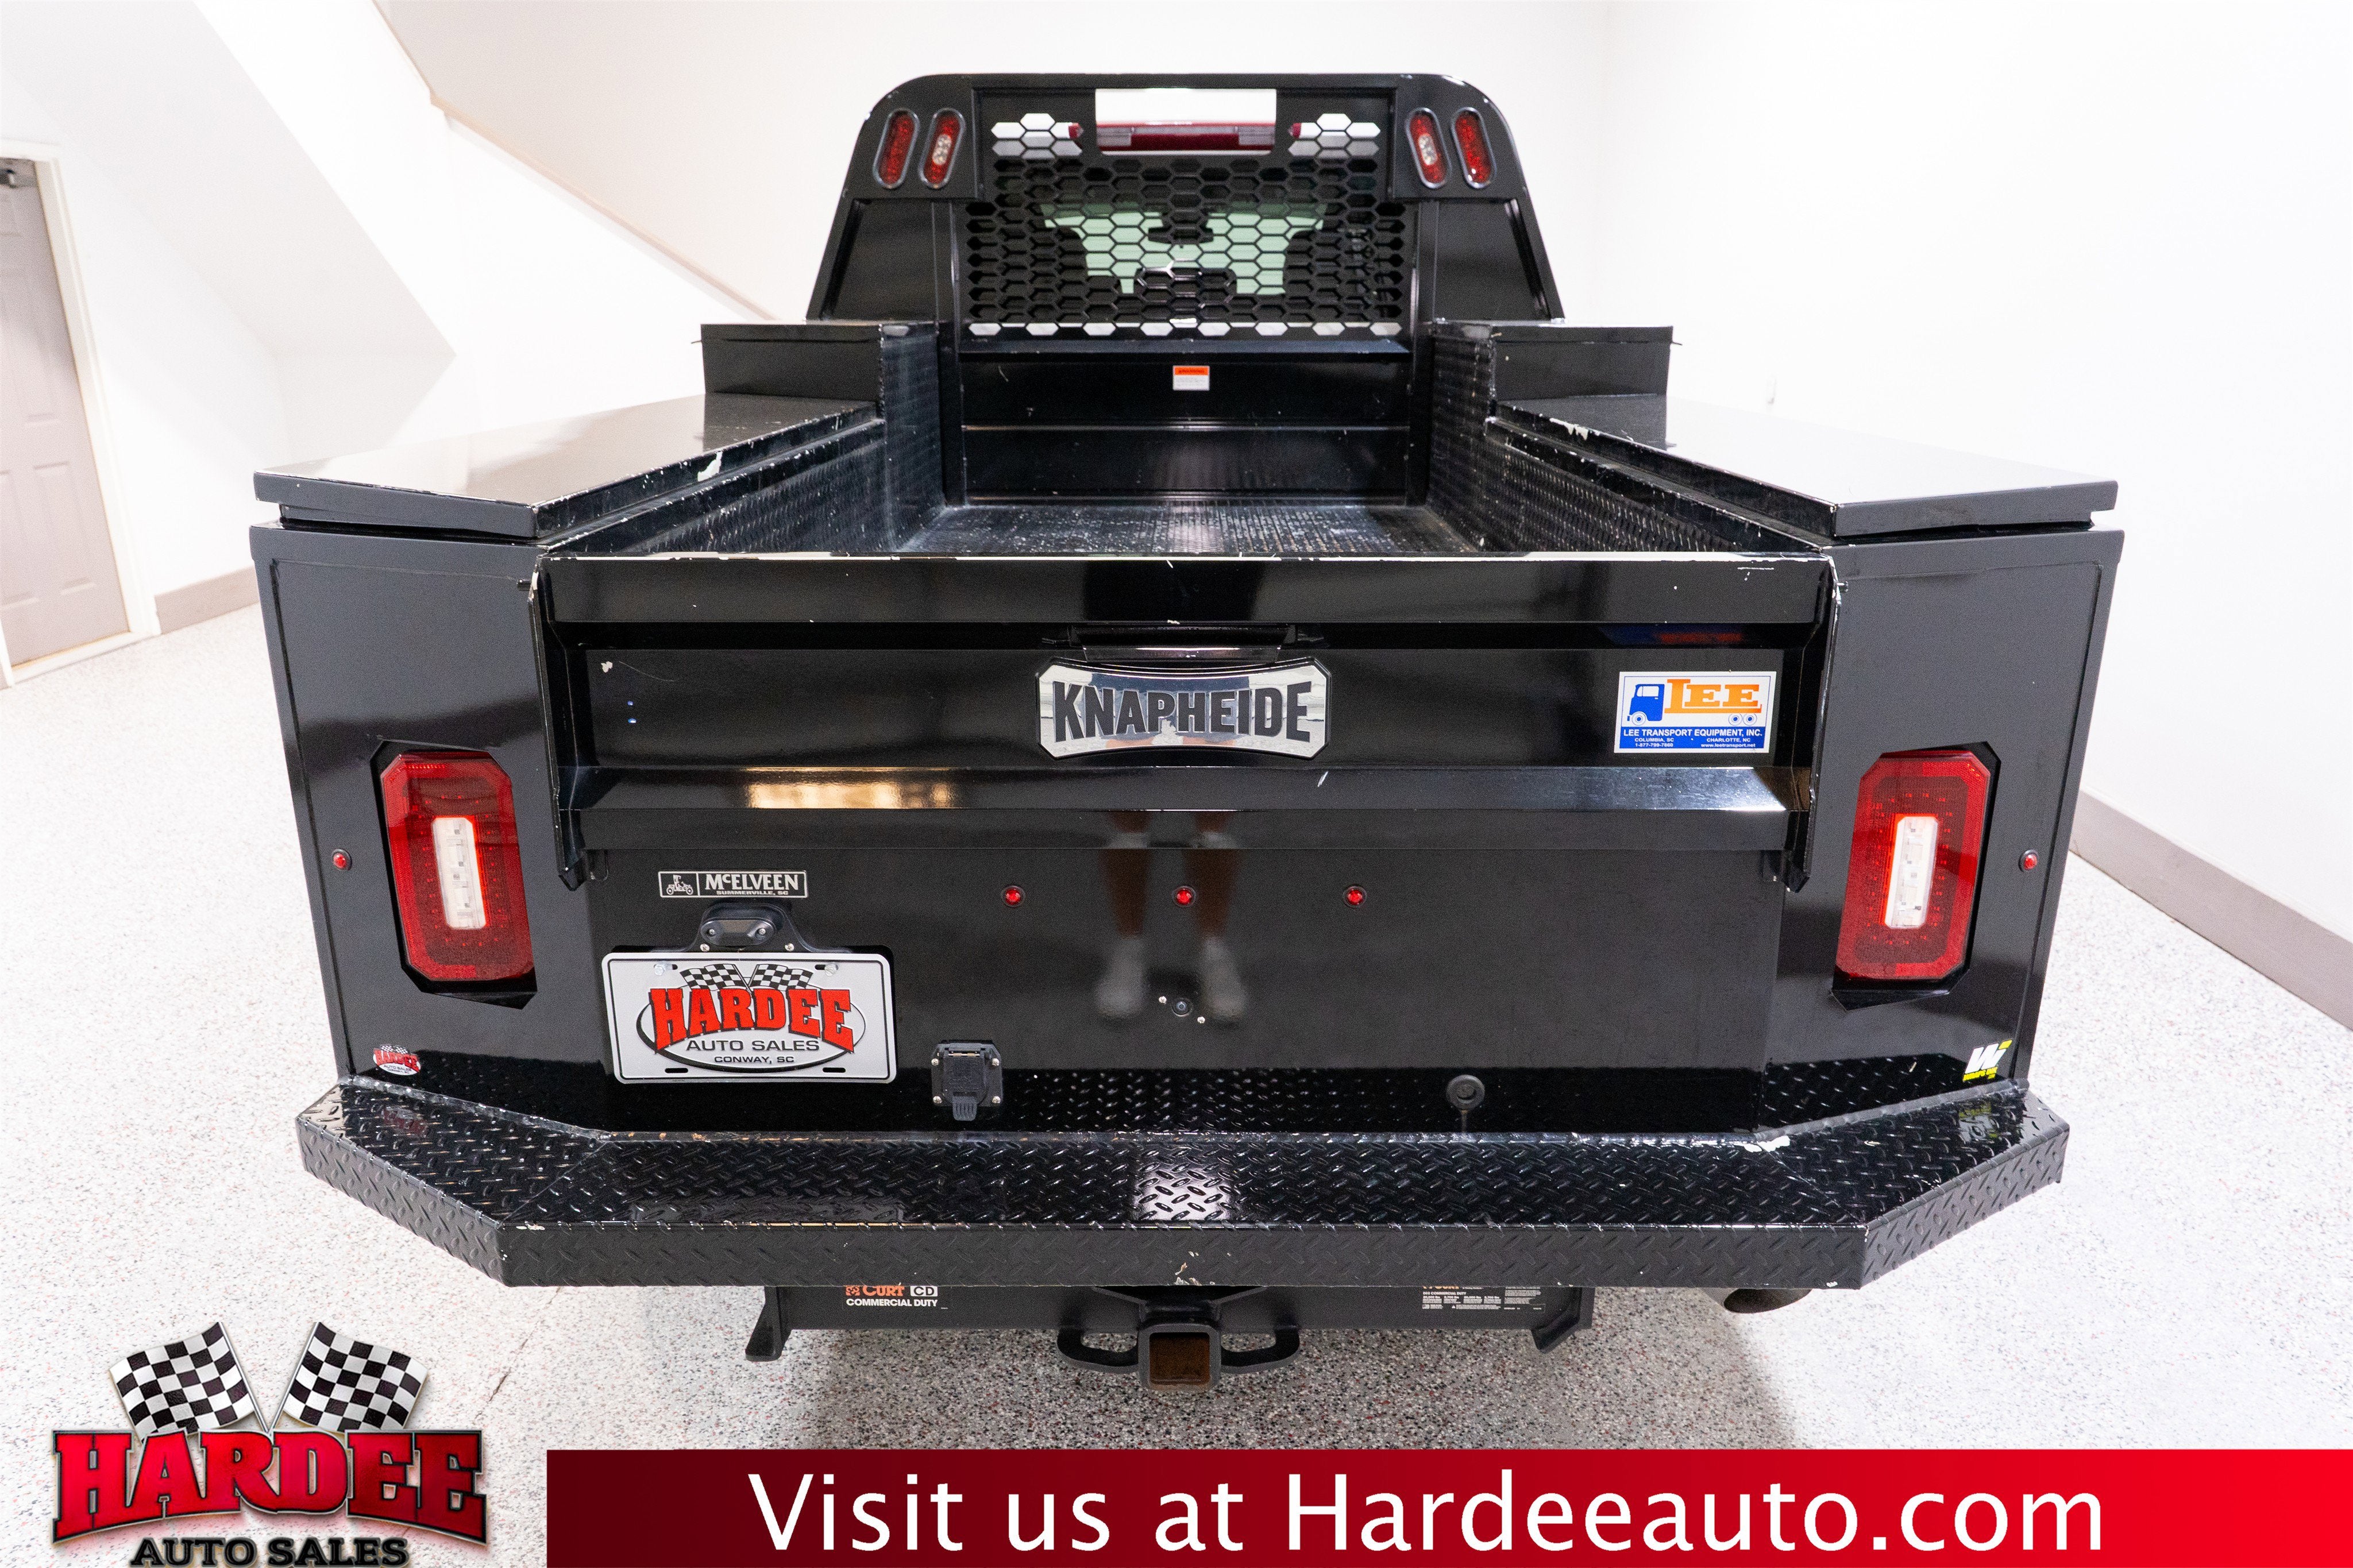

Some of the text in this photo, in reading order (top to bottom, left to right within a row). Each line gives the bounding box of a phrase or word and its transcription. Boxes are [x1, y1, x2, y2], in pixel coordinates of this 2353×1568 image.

[1664, 679, 1762, 713] LEE
[1052, 680, 1313, 743] KNAPHEIDE
[1694, 729, 1744, 737] EQUIPMENT,
[648, 988, 854, 1053] HARDEE
[686, 1040, 820, 1051] AUTO SALES
[862, 1285, 935, 1296] CURT CD
[846, 1299, 912, 1307] COMMERCIAL
